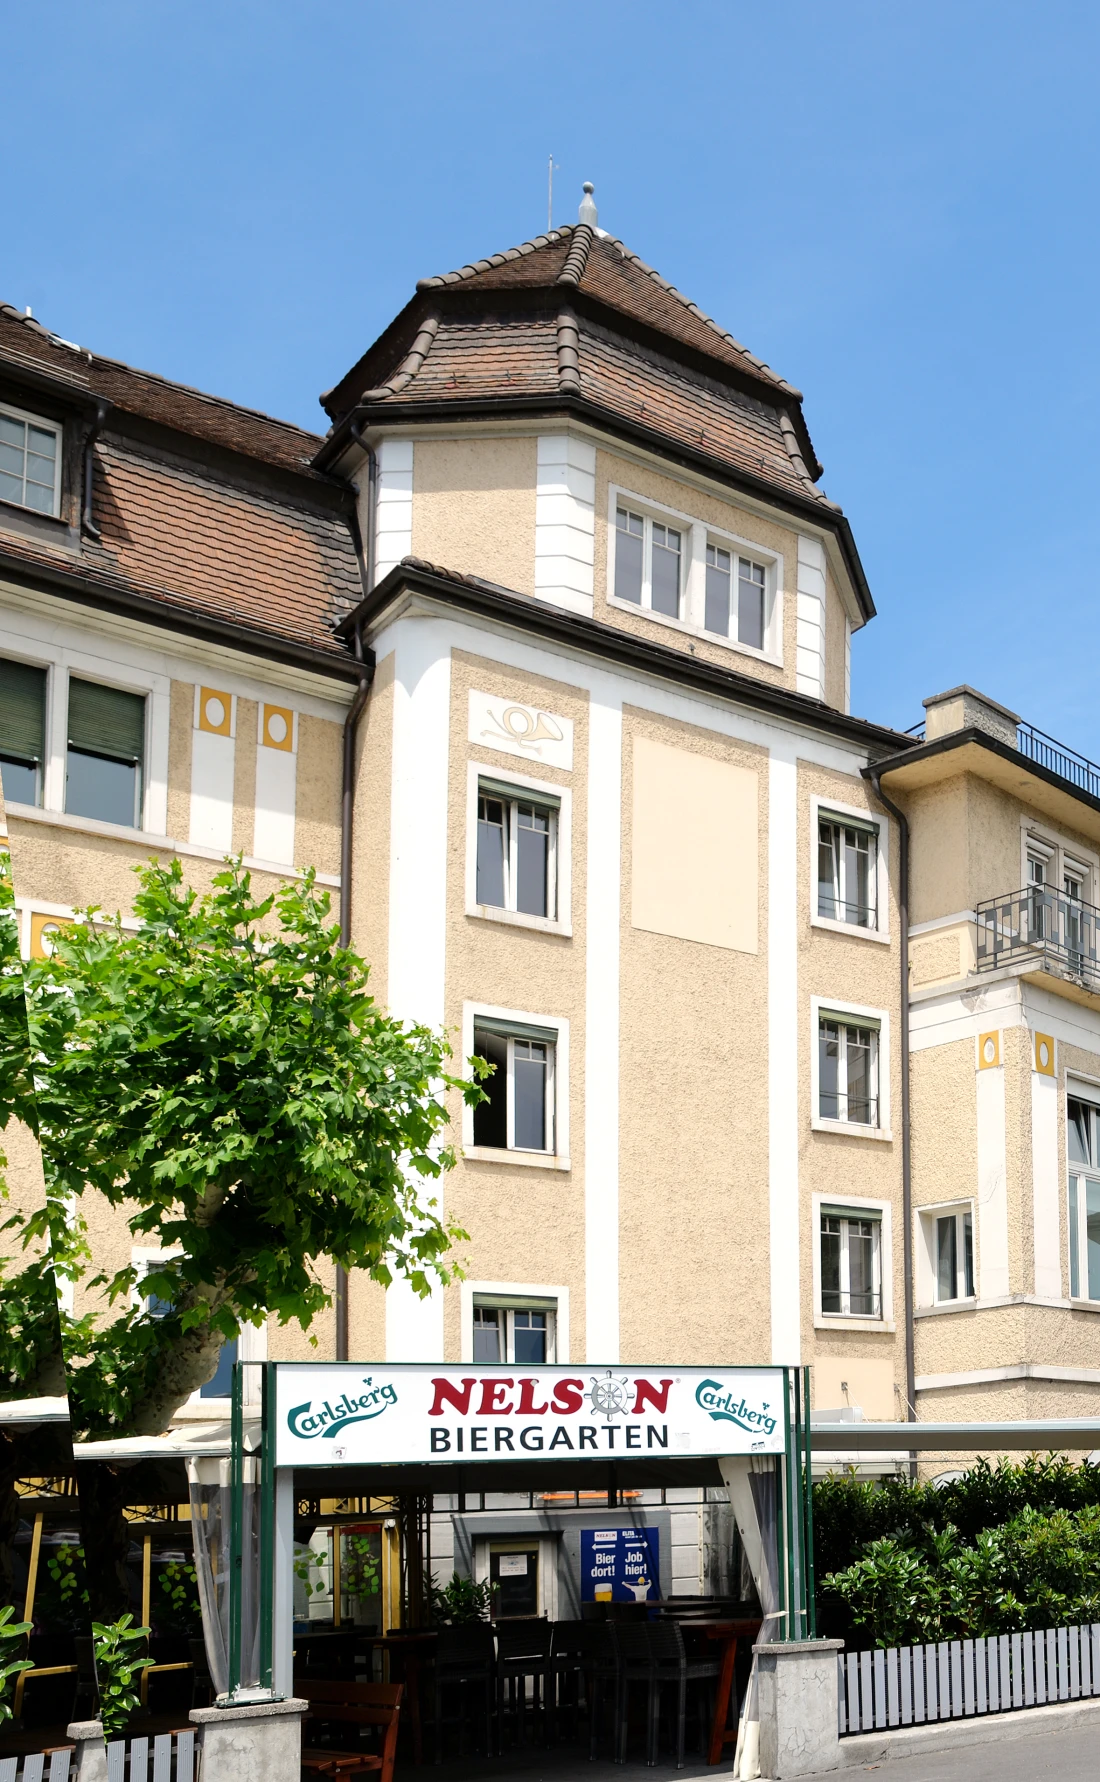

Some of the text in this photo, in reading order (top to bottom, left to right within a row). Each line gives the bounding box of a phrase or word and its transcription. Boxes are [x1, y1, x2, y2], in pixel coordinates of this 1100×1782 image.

[428, 1373, 673, 1419] NELSON
[287, 1380, 398, 1439] Carlsberg
[695, 1378, 777, 1436] Carlsberg
[430, 1424, 669, 1453] BIERGARTEN
[596, 1553, 616, 1565] Bier
[625, 1551, 643, 1563] Job
[591, 1565, 615, 1577] dort!
[625, 1563, 647, 1575] hier!
